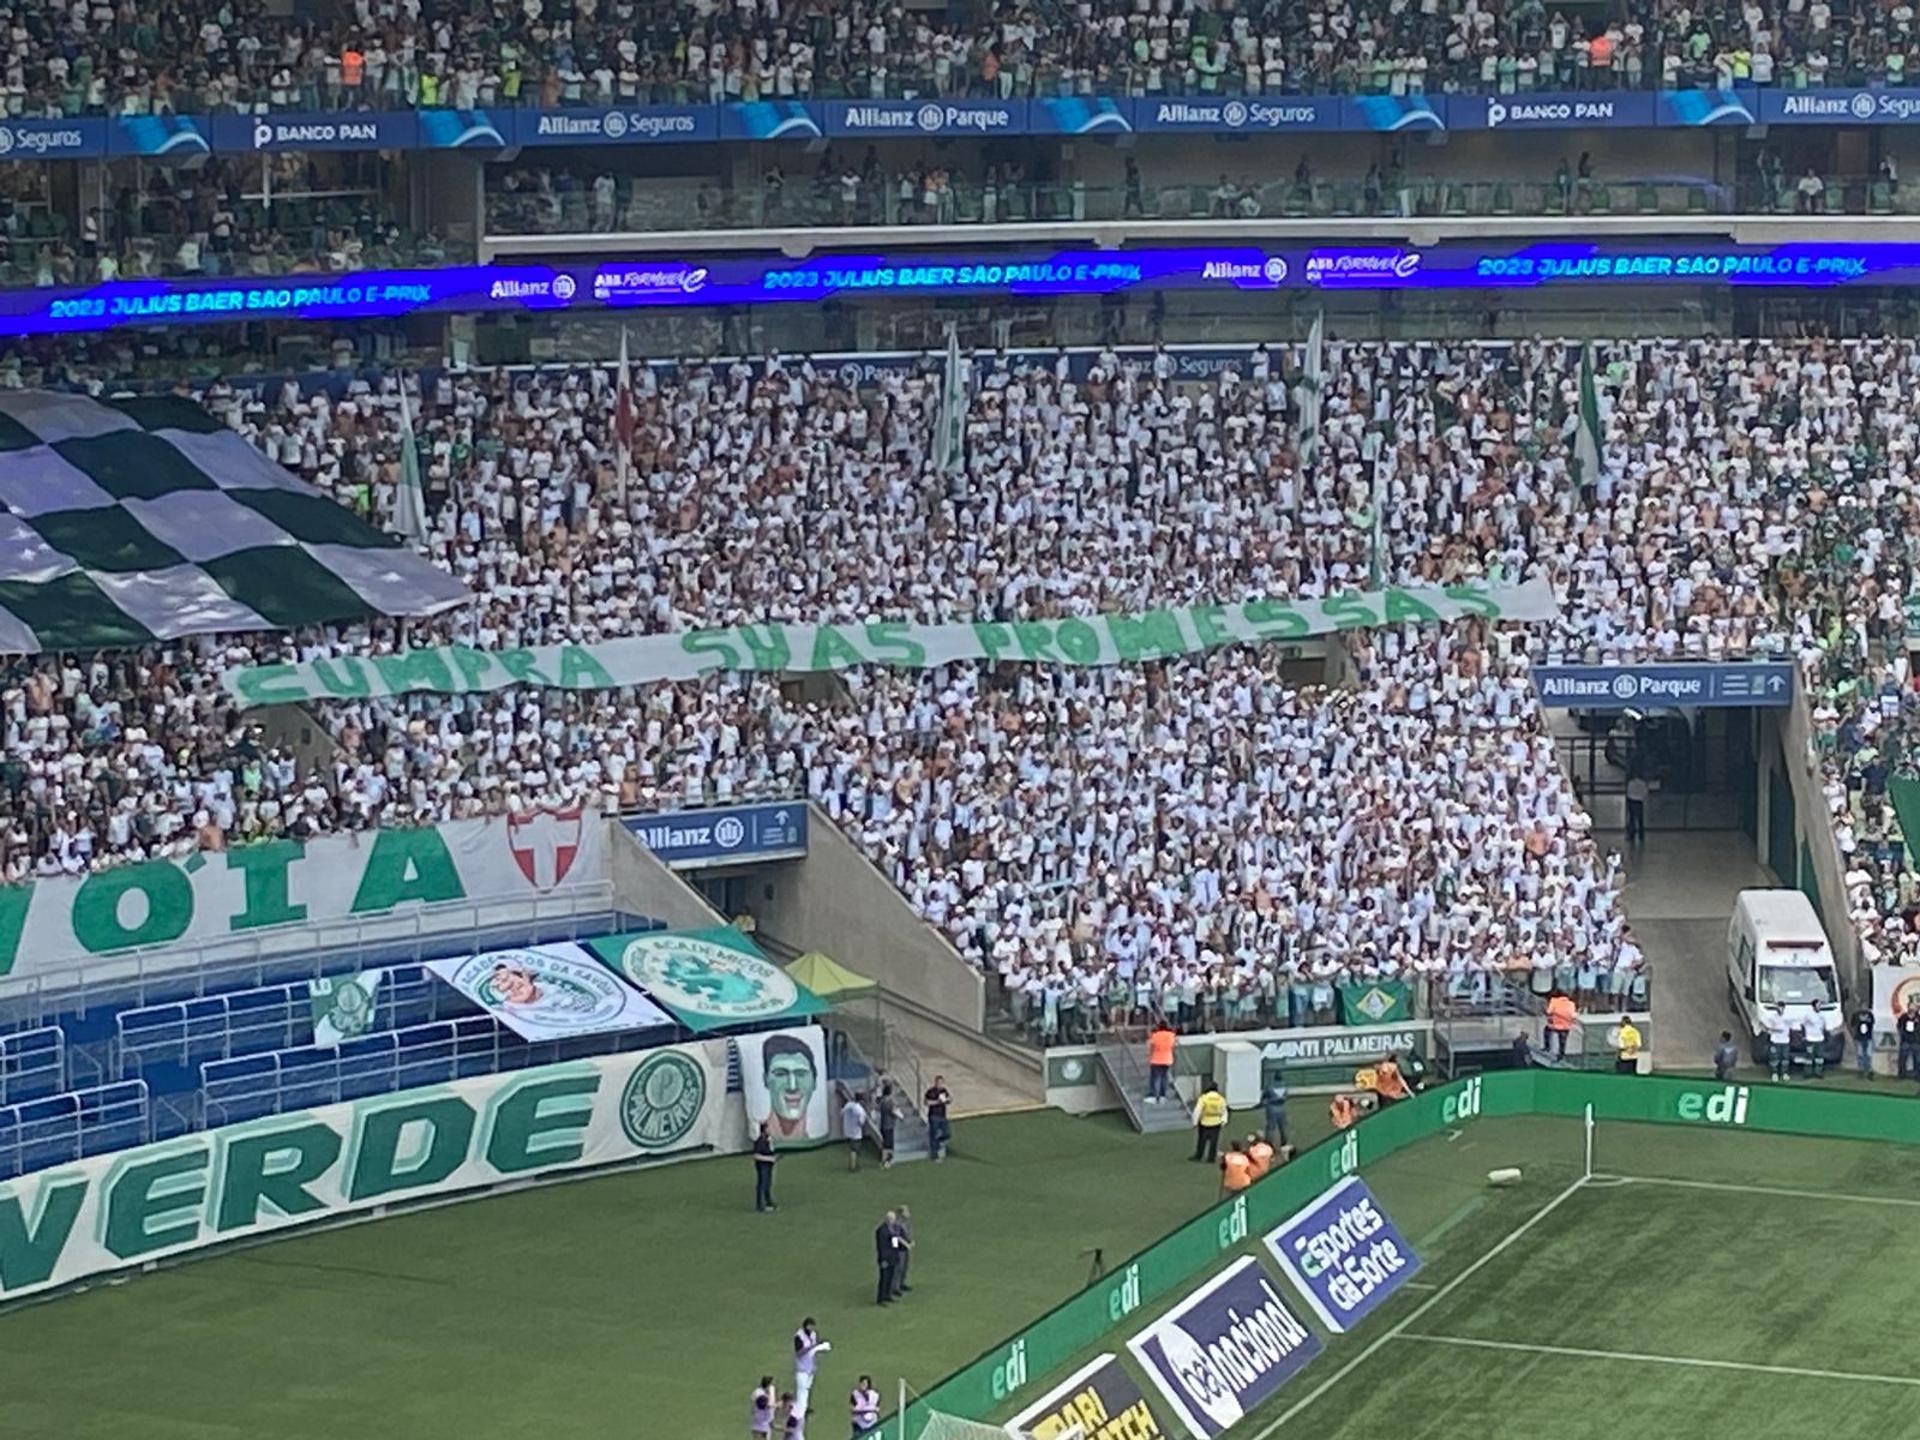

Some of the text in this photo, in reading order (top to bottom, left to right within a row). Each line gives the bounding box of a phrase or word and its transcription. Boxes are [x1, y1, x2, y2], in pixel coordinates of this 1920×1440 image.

[1157, 103, 1314, 126] Allianz Seguros
[1511, 102, 1613, 119] BANCO PAN
[1784, 96, 1848, 114] Allianz
[538, 114, 694, 136] Allianz Seguros
[845, 107, 1008, 131] Allianz Parque
[16, 128, 82, 152] Seguros
[277, 124, 376, 141] BANCO PAN
[764, 271, 818, 289] 2023
[823, 269, 894, 288] JULIUS
[898, 267, 955, 286] BAER
[1004, 264, 1072, 283] PAULO
[1202, 261, 1260, 279] Allianz
[1477, 258, 1532, 276] 2023
[1537, 257, 1610, 276] JULIUS
[1614, 256, 1671, 275] BAER
[1722, 255, 1792, 274] PAULO
[110, 294, 181, 316] JULIUS
[184, 290, 243, 311] BAER
[293, 285, 361, 306] PAULO
[491, 280, 549, 299] Allianz
[238, 585, 1500, 699] CUMPRA SUAS PROMESSAS
[1543, 678, 1609, 695] Allianz
[1641, 677, 1701, 698] Parque
[1324, 1033, 1415, 1055] PALMEIRAS
[1443, 1077, 1481, 1123] edi
[1677, 1086, 1749, 1124] edi
[1329, 1129, 1358, 1179] edi
[0, 1058, 601, 1292] VERDE
[1218, 1195, 1247, 1250] edi
[1108, 1264, 1140, 1321] edi
[992, 1338, 1026, 1400] edi
